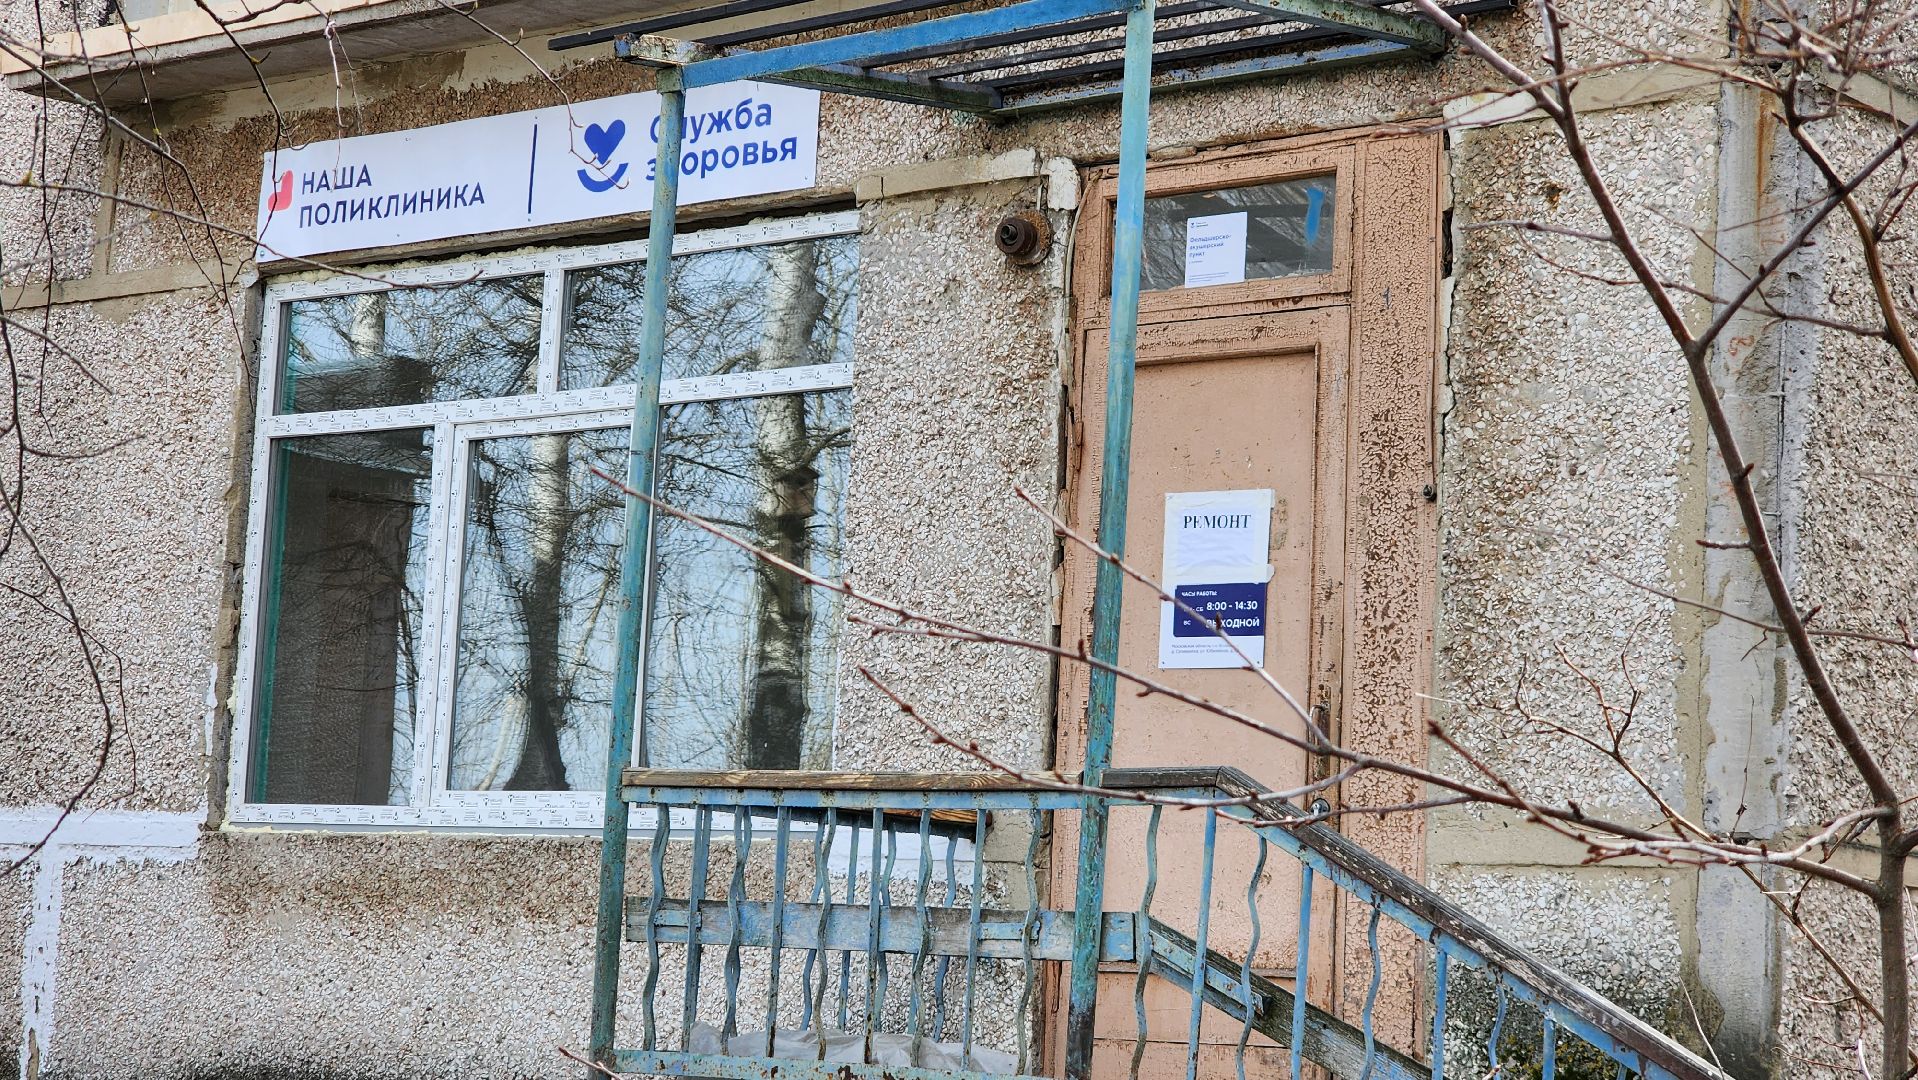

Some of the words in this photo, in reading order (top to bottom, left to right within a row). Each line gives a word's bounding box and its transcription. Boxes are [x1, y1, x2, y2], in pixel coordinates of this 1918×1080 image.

[645, 136, 798, 180] зоровья
[302, 163, 372, 195] НАША
[299, 181, 485, 229] ПОЛИКЛИНИКА
[1183, 514, 1252, 529] РЕМОНТ
[1206, 601, 1227, 611] 8:00
[1234, 600, 1258, 610] 14:30
